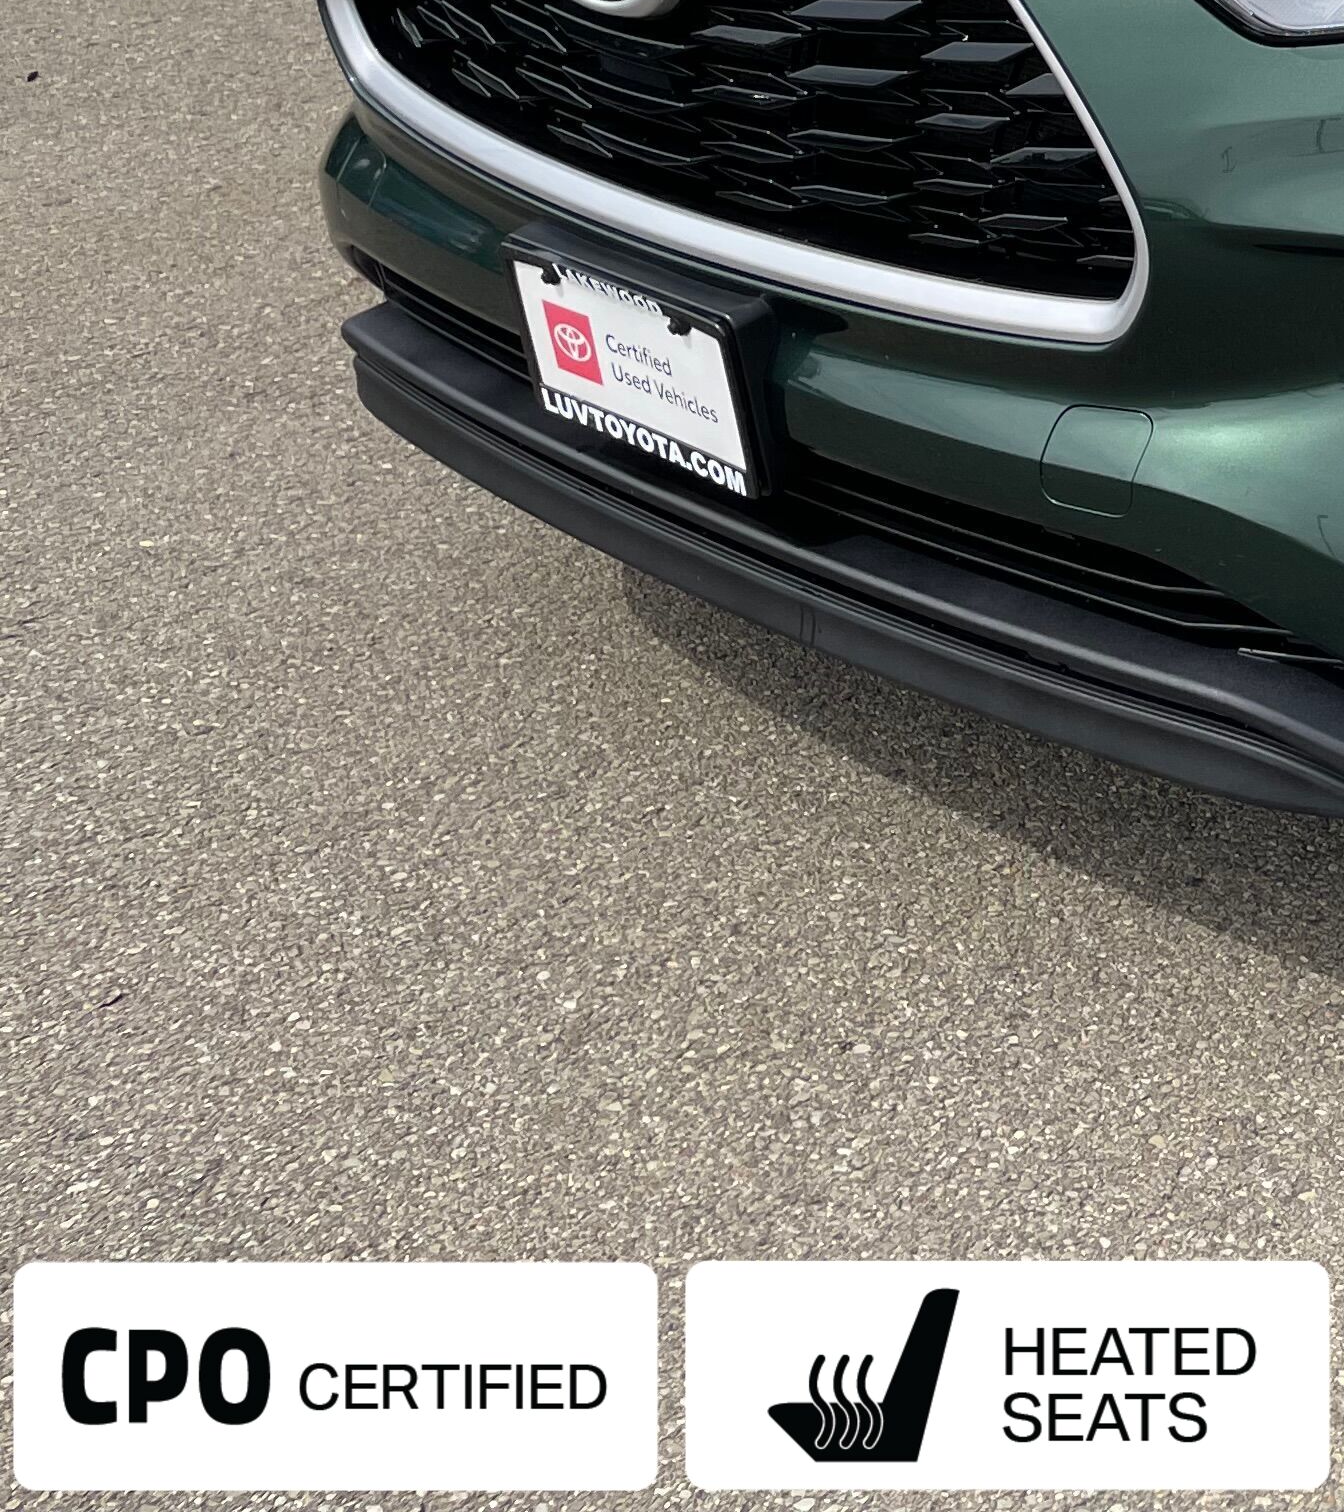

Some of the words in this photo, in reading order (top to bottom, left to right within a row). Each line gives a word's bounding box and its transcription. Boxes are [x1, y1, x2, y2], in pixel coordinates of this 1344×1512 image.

[552, 263, 664, 316] LAKEWOOD
[605, 333, 673, 377] Certified
[611, 362, 652, 395] Used
[654, 379, 719, 424] Vehicles
[541, 387, 748, 497] LUVTOYOTA.COM
